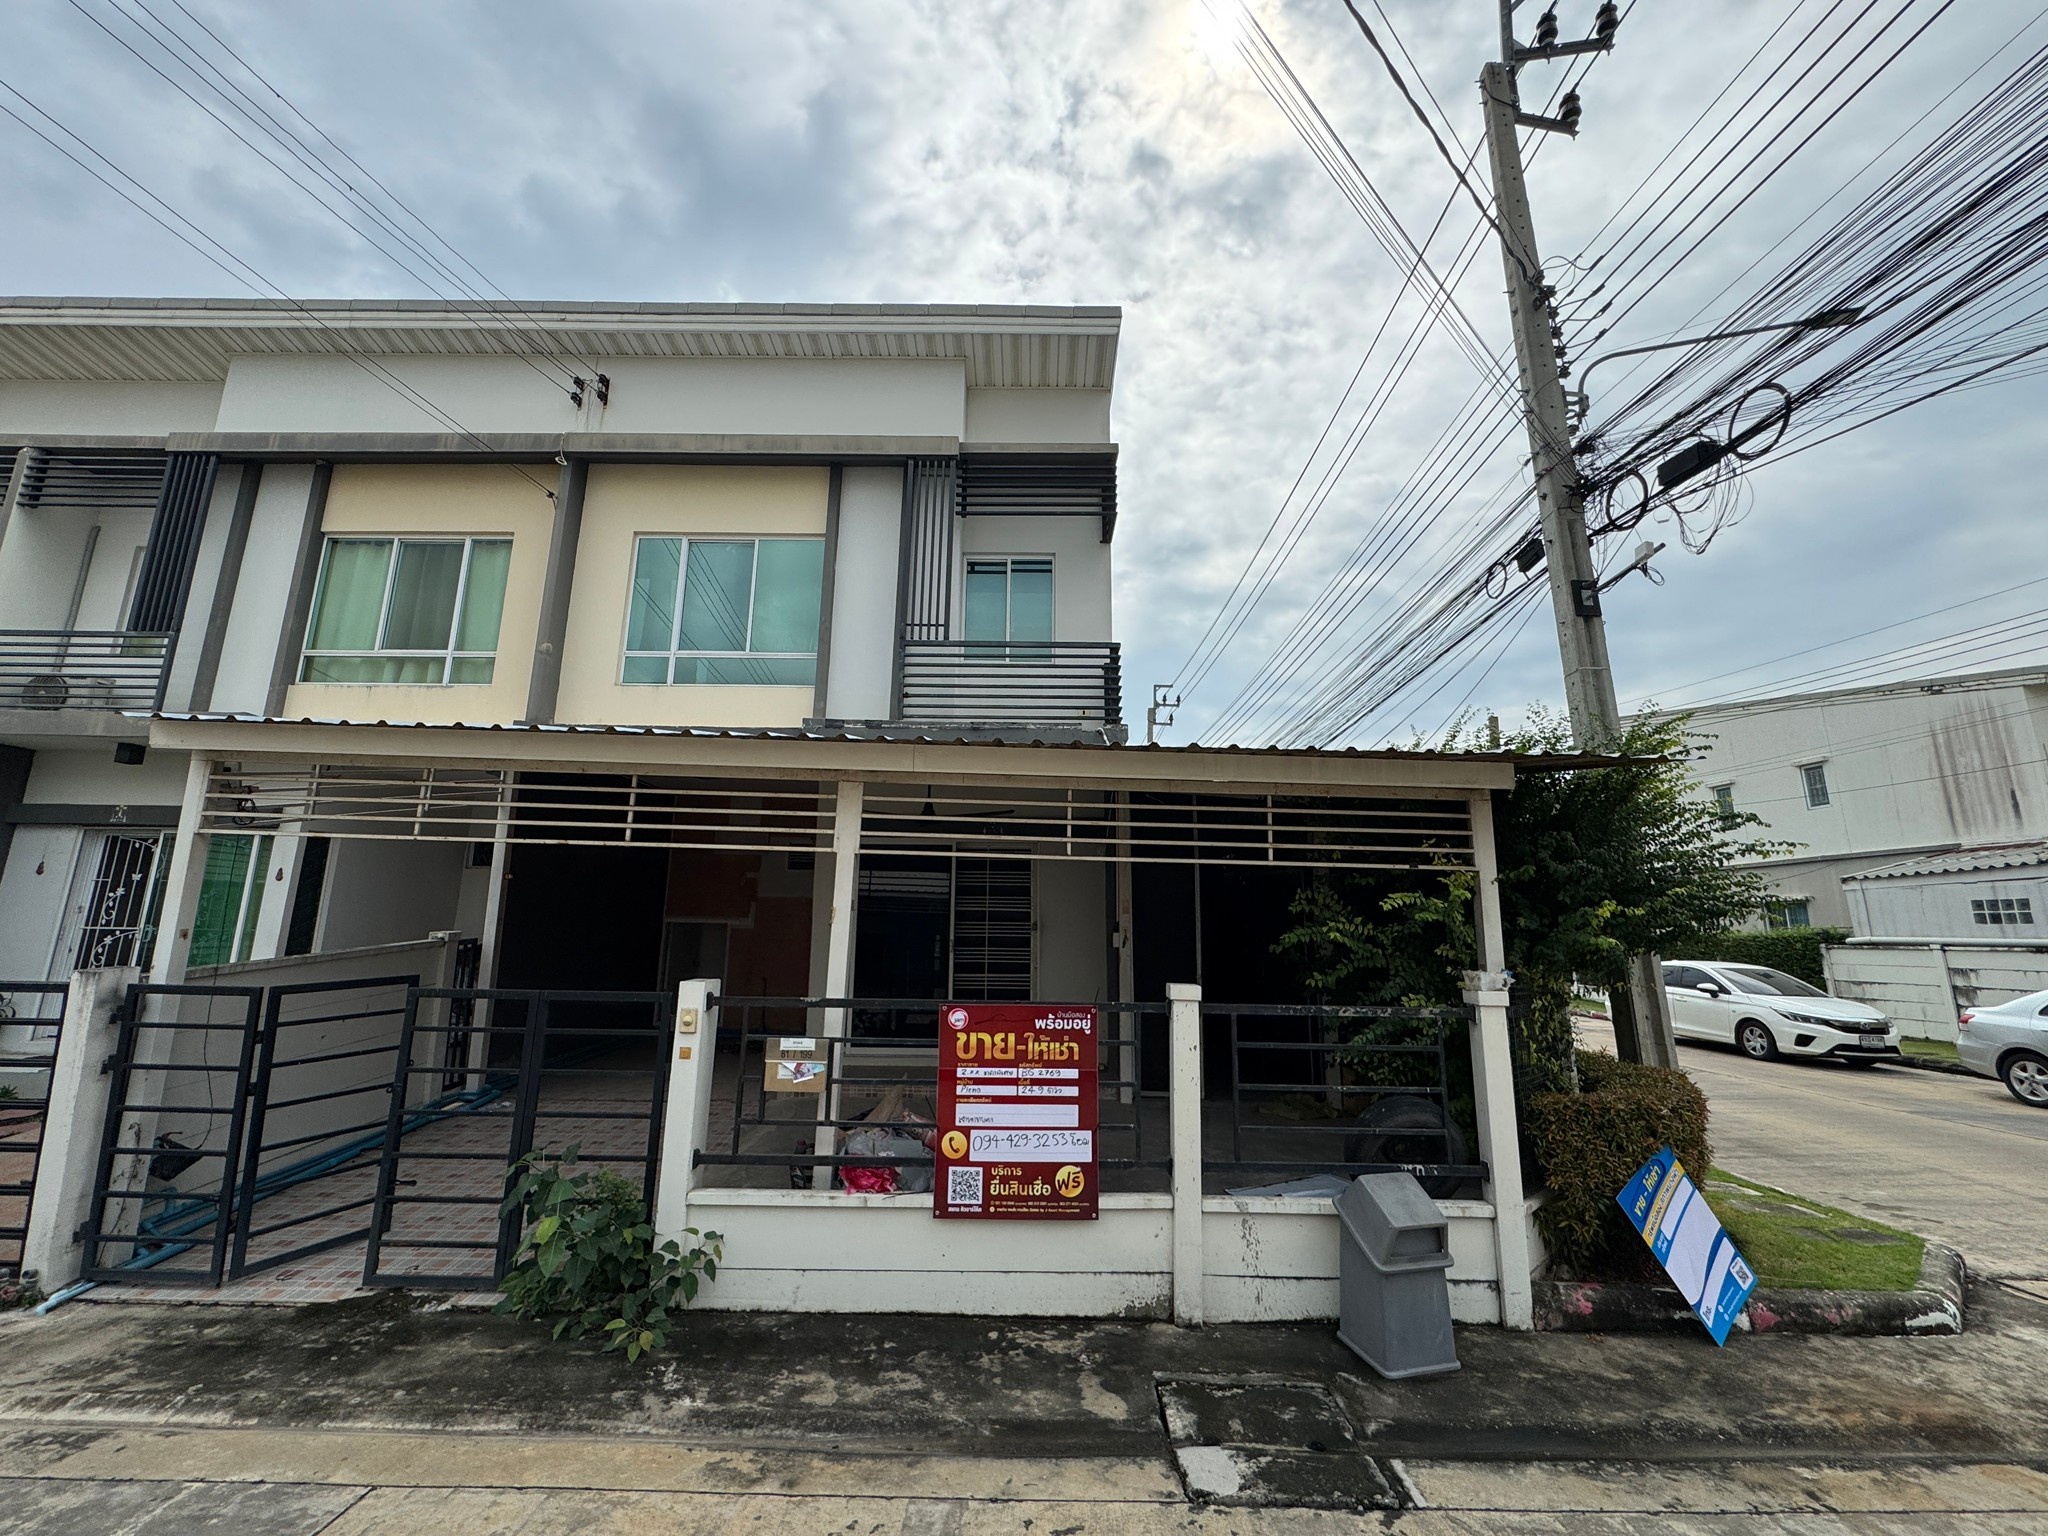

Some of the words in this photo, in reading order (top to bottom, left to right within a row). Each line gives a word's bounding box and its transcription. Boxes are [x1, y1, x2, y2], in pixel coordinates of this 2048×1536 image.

[1035, 1013, 1091, 1035] พร้อมอยู่
[991, 1165, 1023, 1176] บริการ
[989, 1176, 1052, 1196] ยื่นสินเชื่อ
[1057, 1171, 1081, 1192] ฟรี
[1634, 1194, 1647, 1217] ขาย
[1642, 1165, 1661, 1193] ให้เช่า
